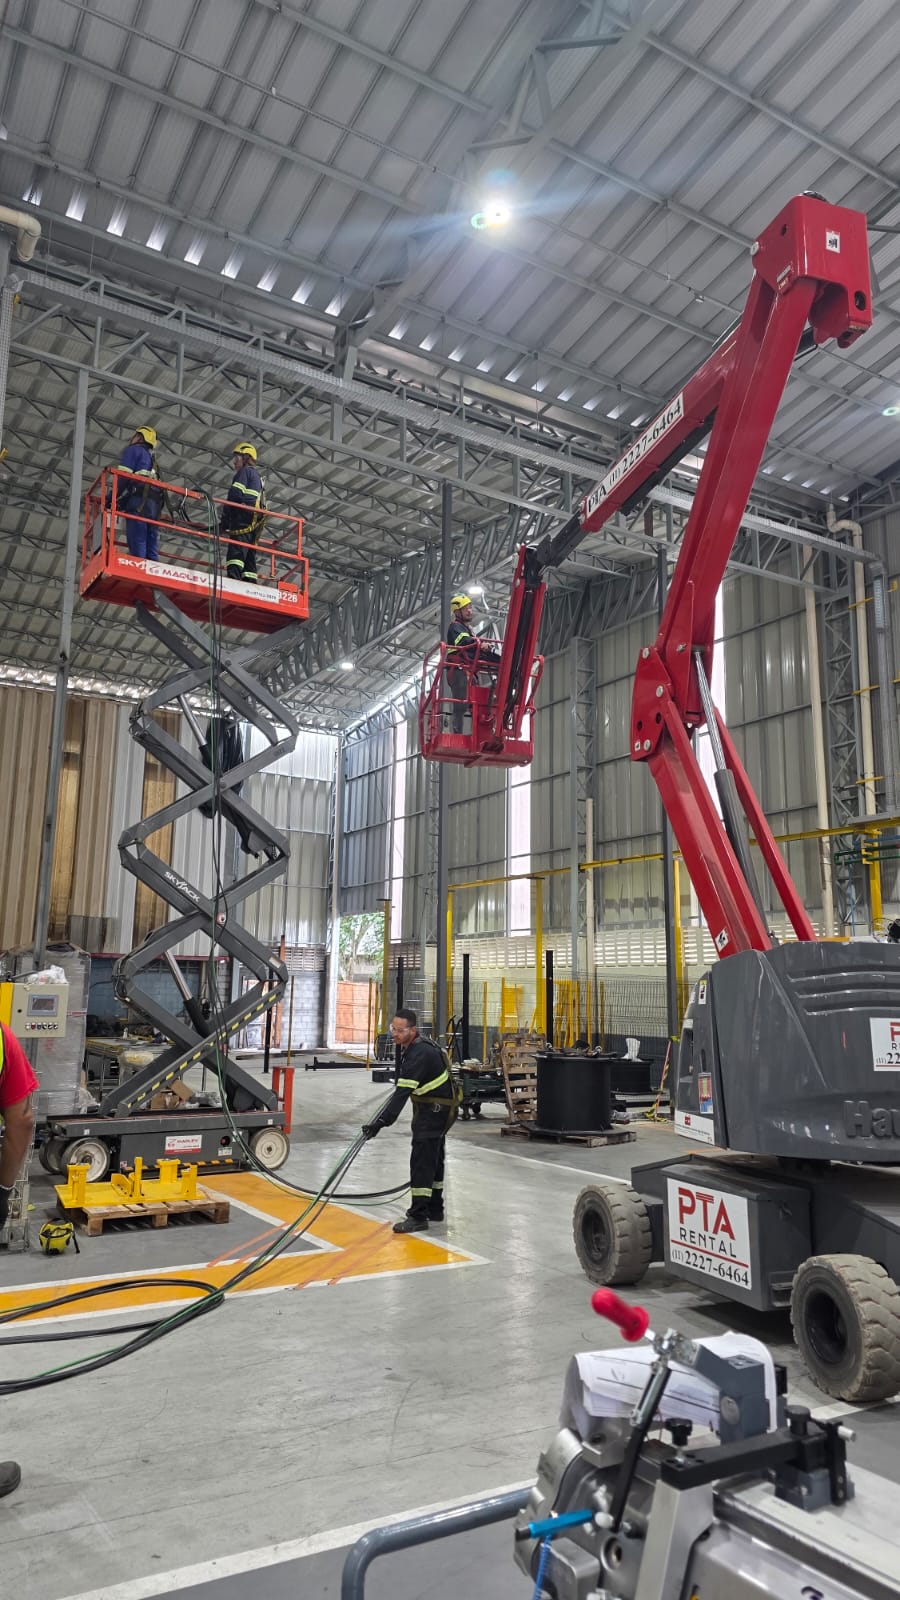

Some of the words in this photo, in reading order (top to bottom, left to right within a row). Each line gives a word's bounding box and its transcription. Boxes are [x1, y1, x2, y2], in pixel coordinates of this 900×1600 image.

[622, 399, 681, 473] 2227-6464
[164, 871, 200, 902] SKYJACK
[678, 1186, 736, 1241] PTA
[679, 1226, 737, 1258] RENTAL
[684, 1250, 749, 1287] 2227-6464
